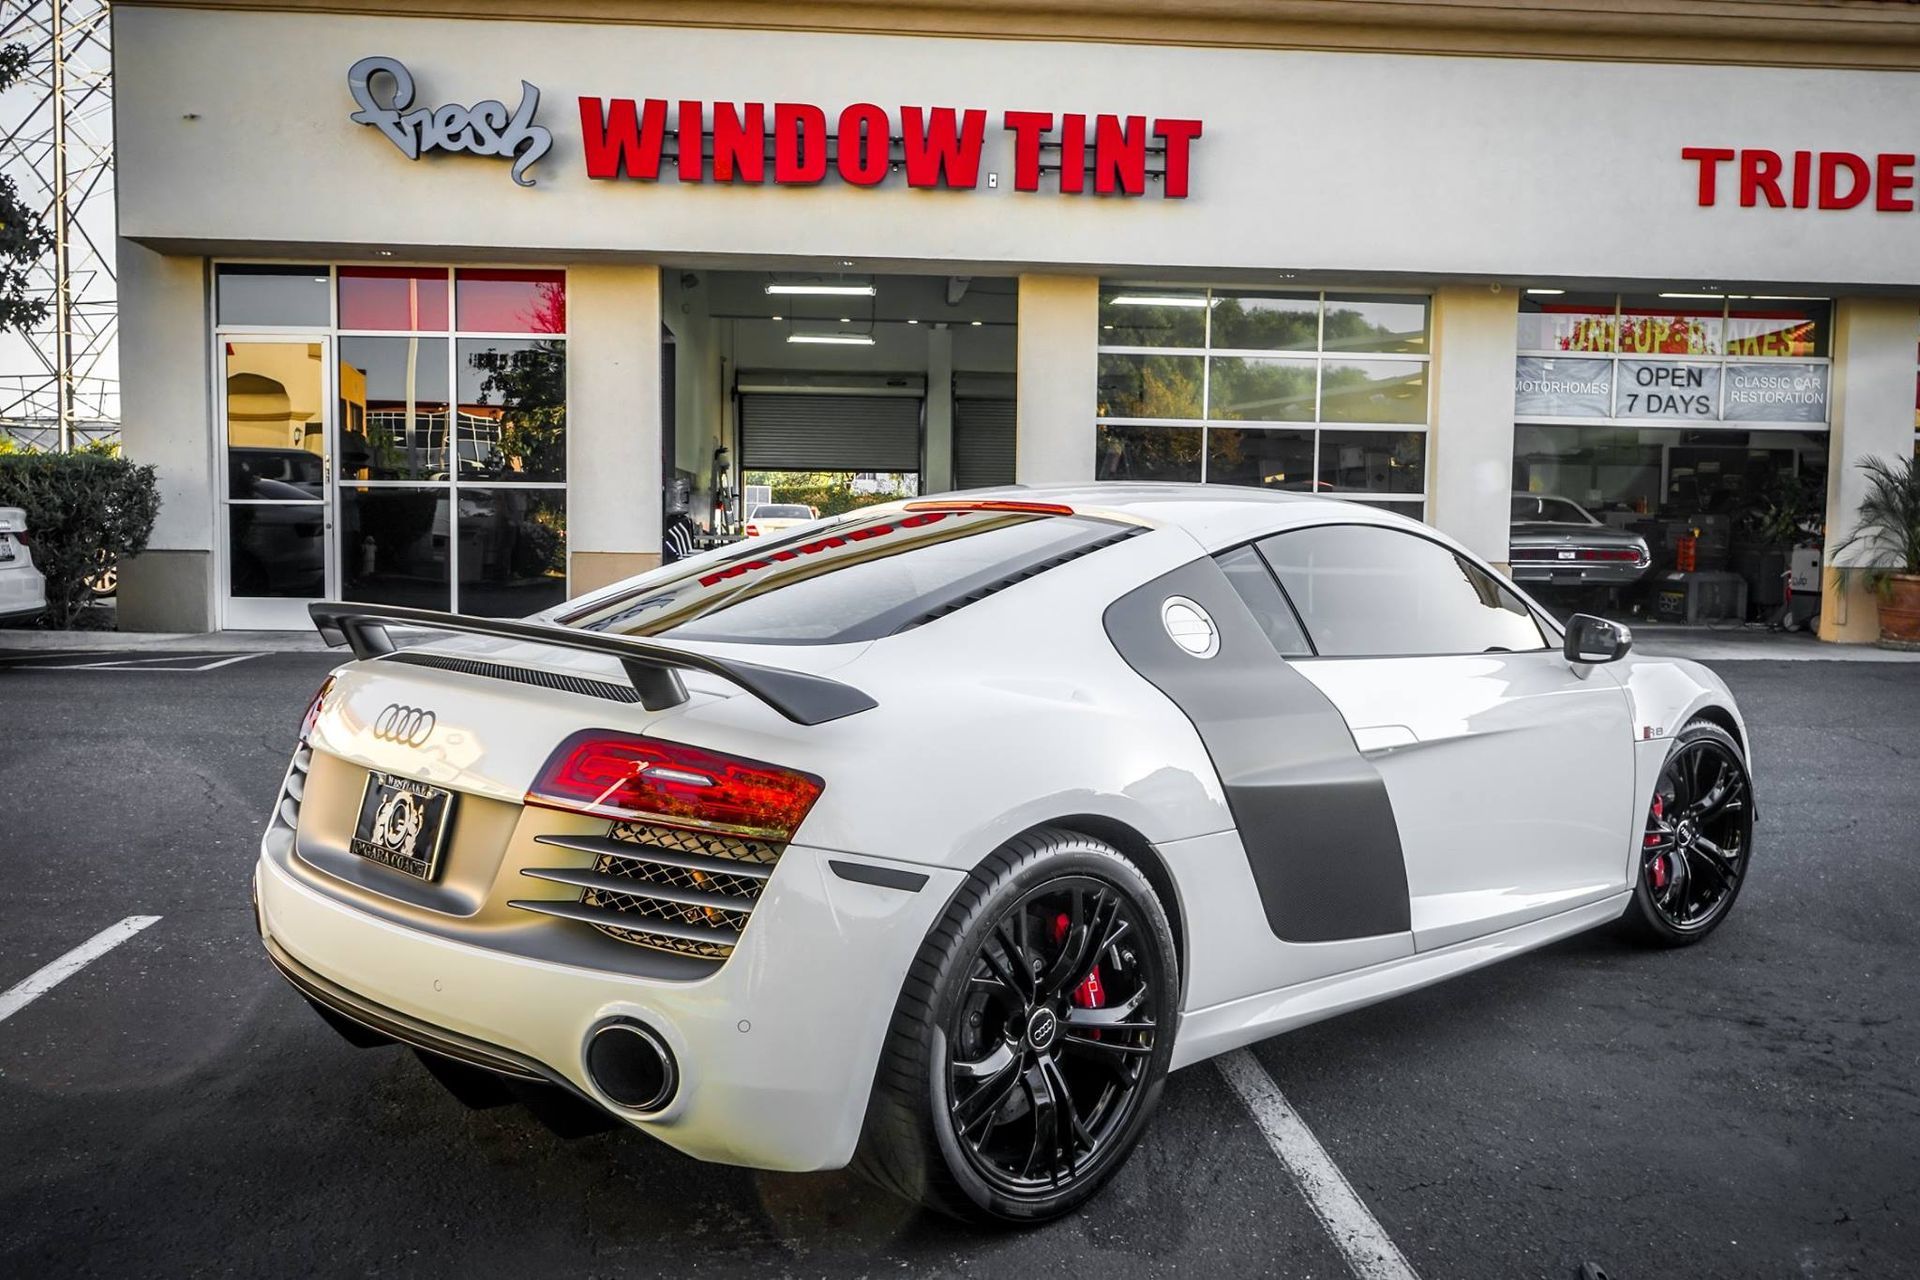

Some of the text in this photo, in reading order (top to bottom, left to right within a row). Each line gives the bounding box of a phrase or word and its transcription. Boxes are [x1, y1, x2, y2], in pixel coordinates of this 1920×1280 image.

[578, 96, 988, 189] WINDOW
[1004, 110, 1203, 198] TINT
[1682, 147, 1915, 212] TRIDE
[1636, 366, 1702, 387] OPEN
[1735, 376, 1821, 390] CLASSIC CAR
[1626, 393, 1710, 414] 7 DAYS
[1731, 390, 1824, 404] RESTORATION
